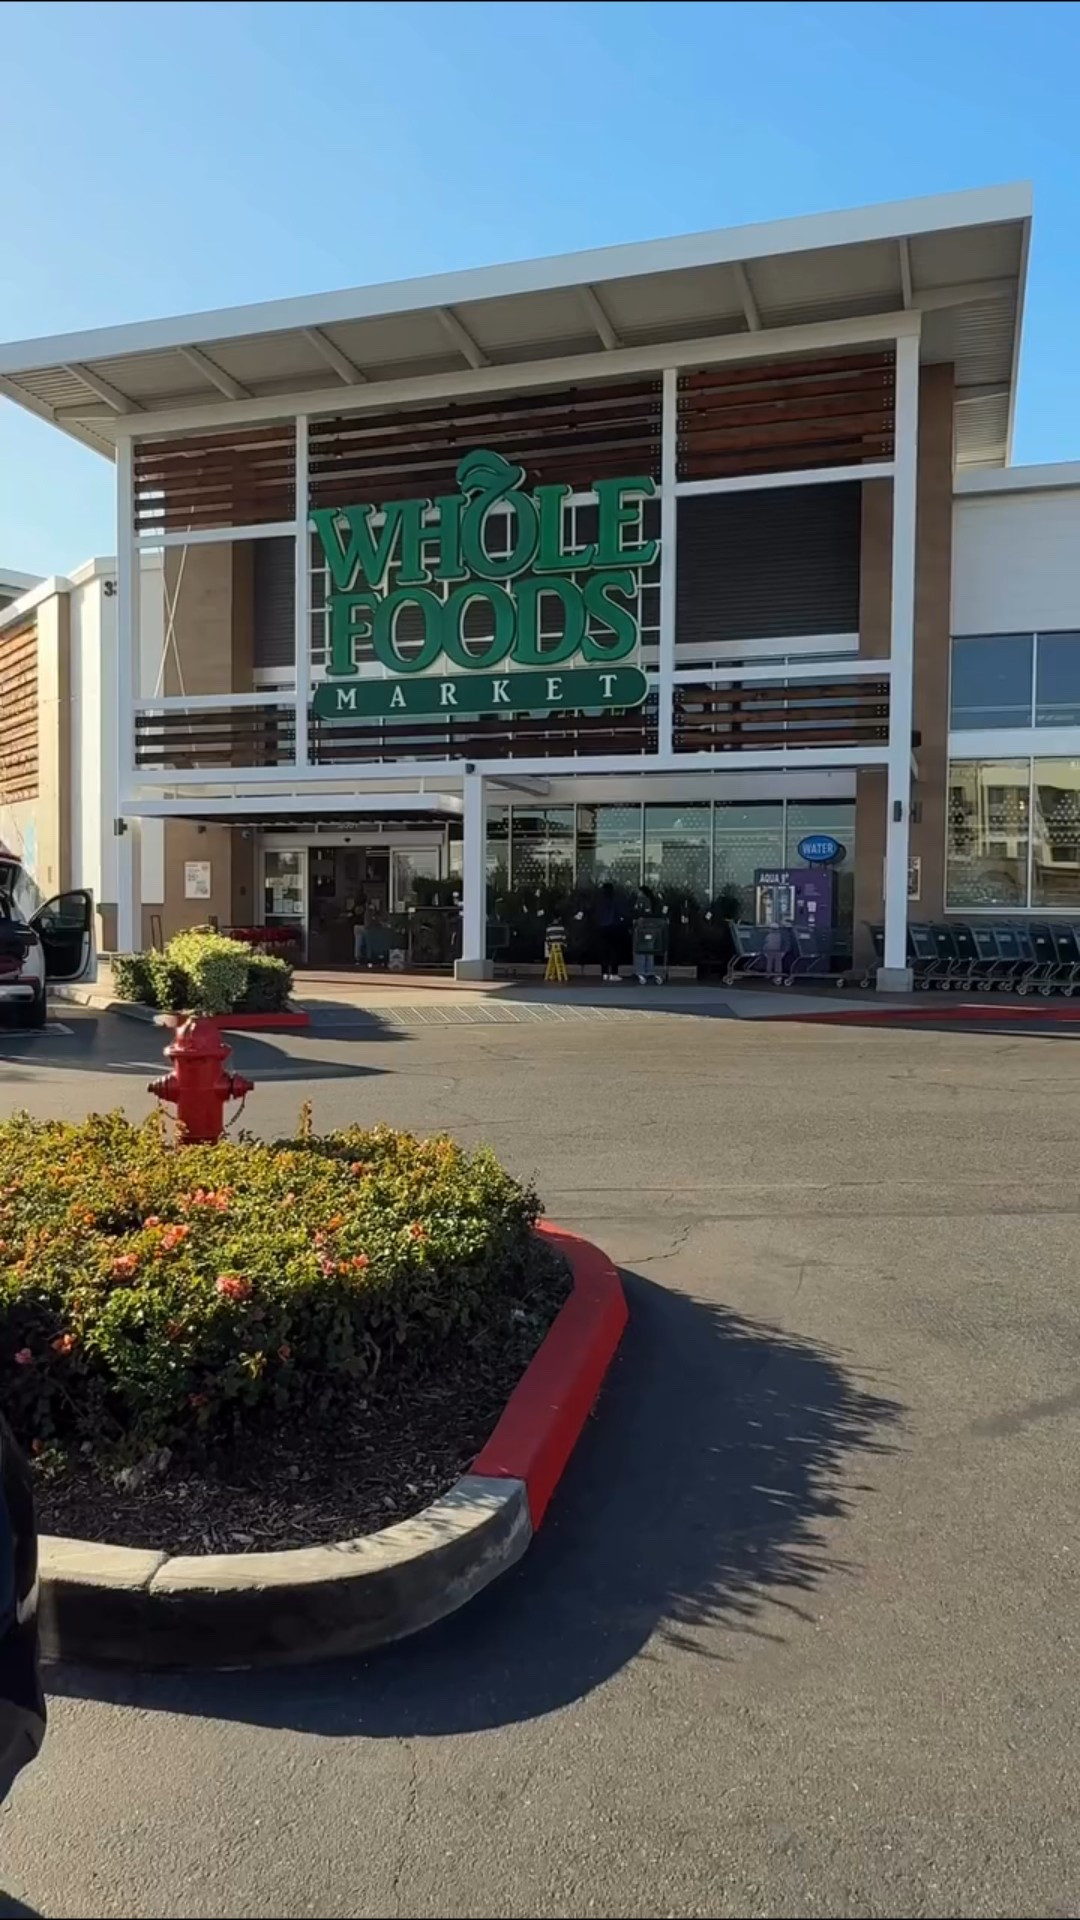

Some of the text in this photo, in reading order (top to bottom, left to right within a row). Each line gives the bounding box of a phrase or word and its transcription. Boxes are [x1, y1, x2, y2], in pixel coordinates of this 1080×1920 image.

[310, 474, 661, 589] WHOLE
[326, 570, 638, 675] FOODS
[336, 674, 618, 710] MARKET
[803, 842, 833, 854] WATER
